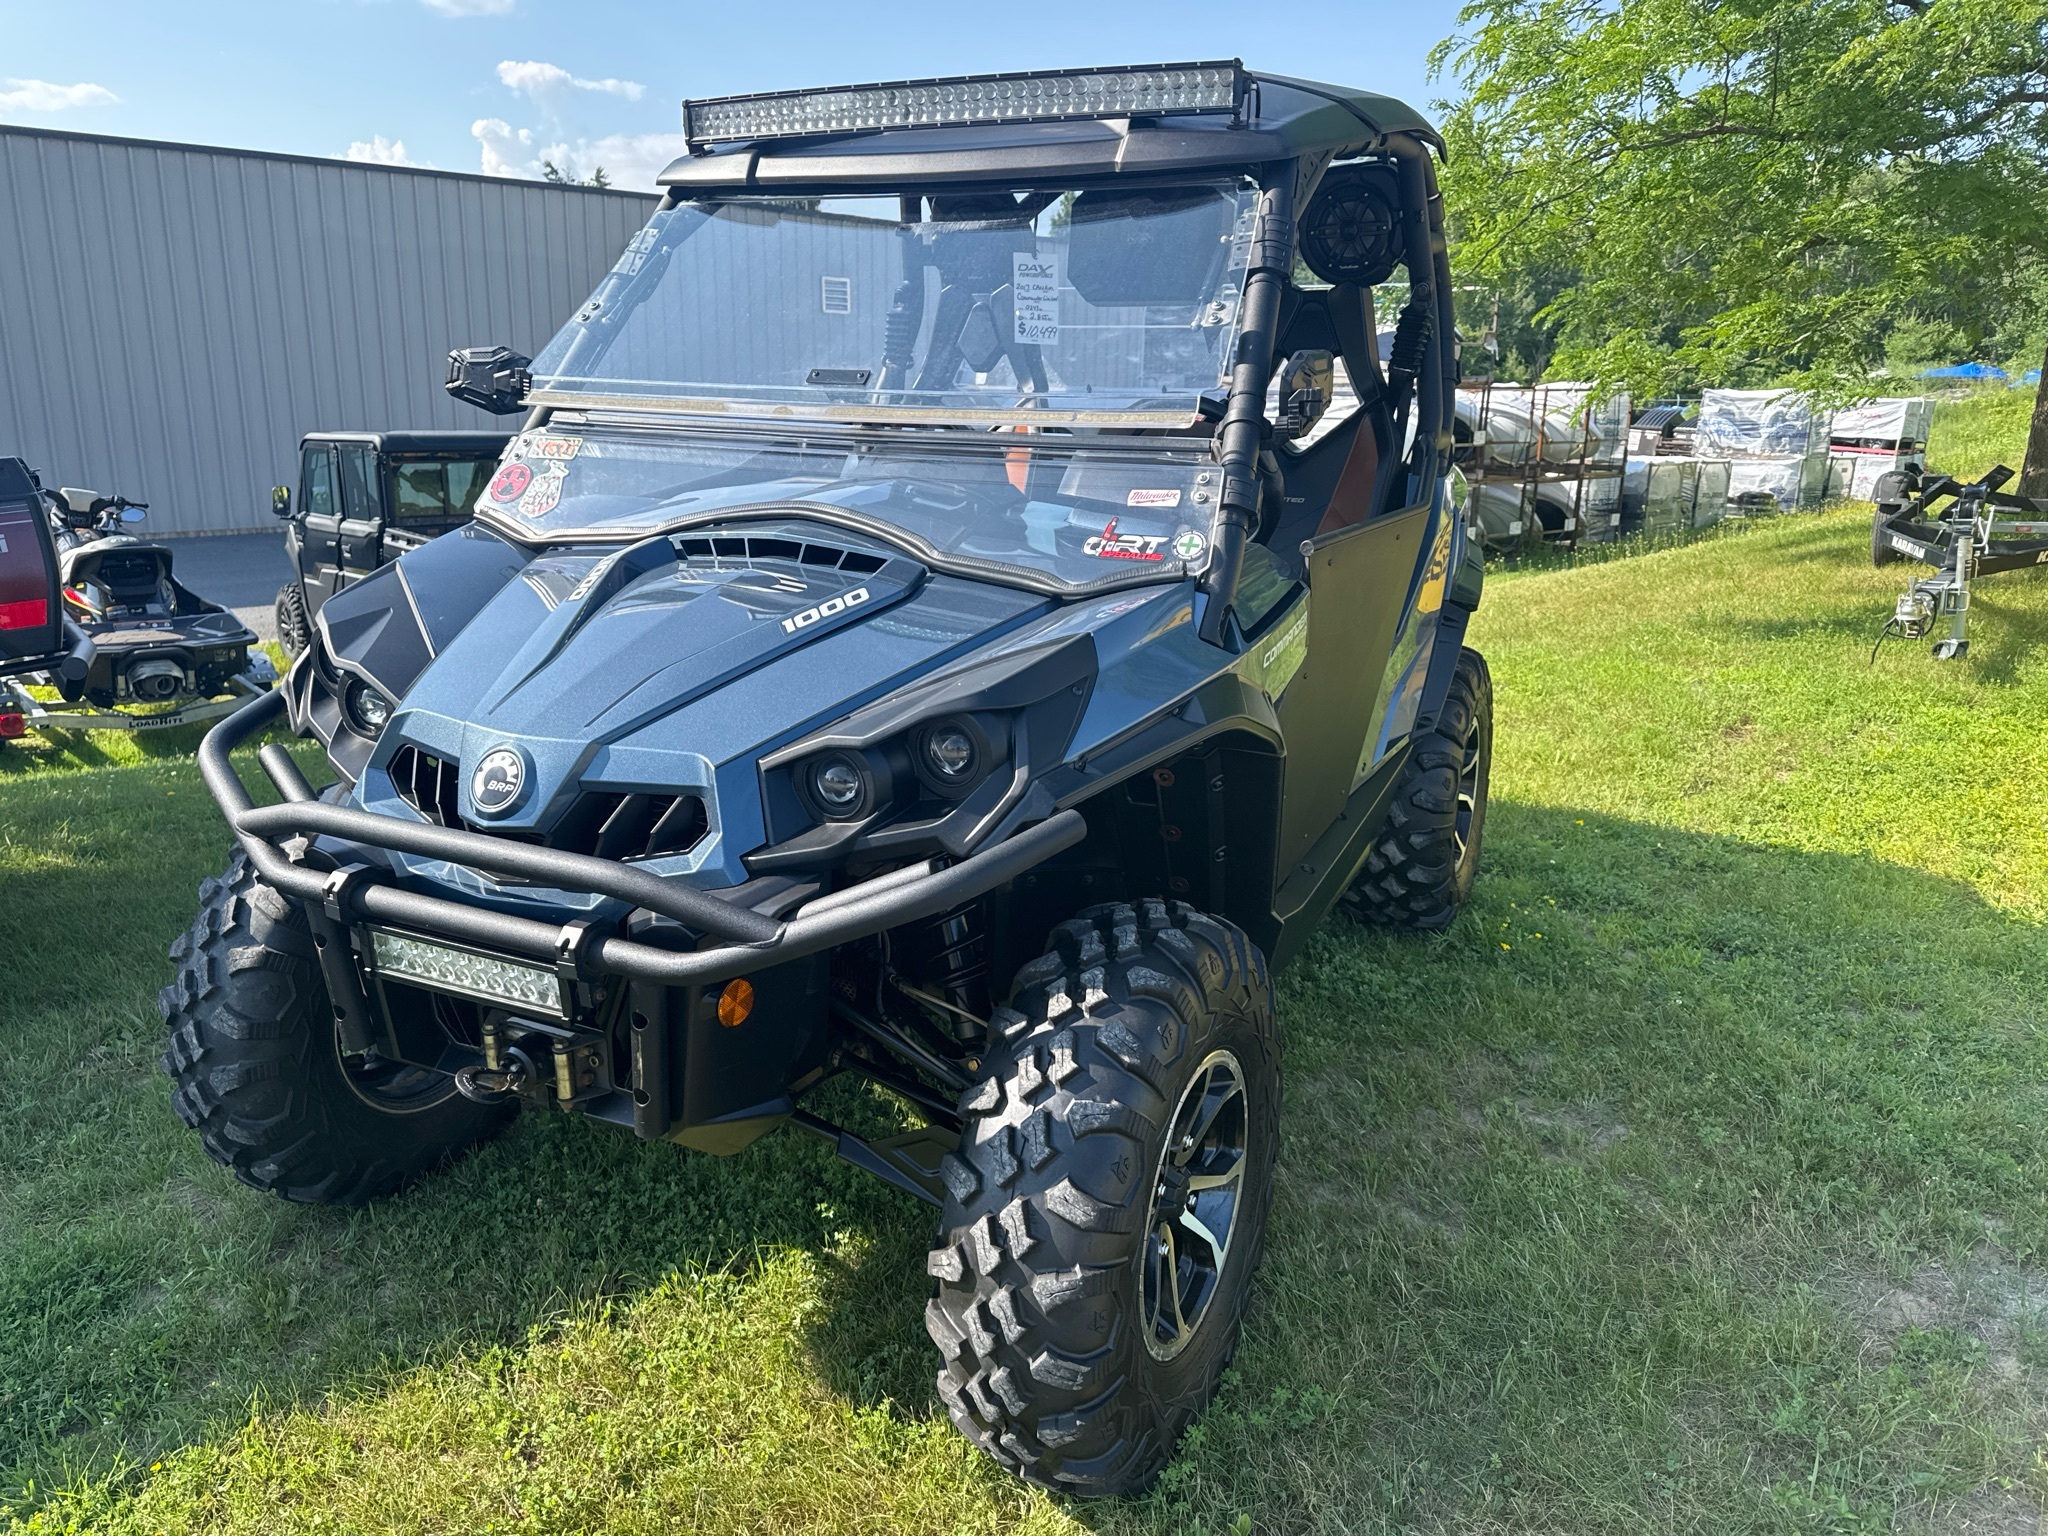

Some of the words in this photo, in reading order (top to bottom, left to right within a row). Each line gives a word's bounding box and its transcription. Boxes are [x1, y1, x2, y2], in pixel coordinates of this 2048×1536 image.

[1017, 264, 1055, 274] DAX
[1130, 491, 1178, 500] Milwaukee
[1891, 535, 1926, 559] KARAVAN
[781, 587, 870, 633] 1000
[487, 780, 514, 792] BRP
